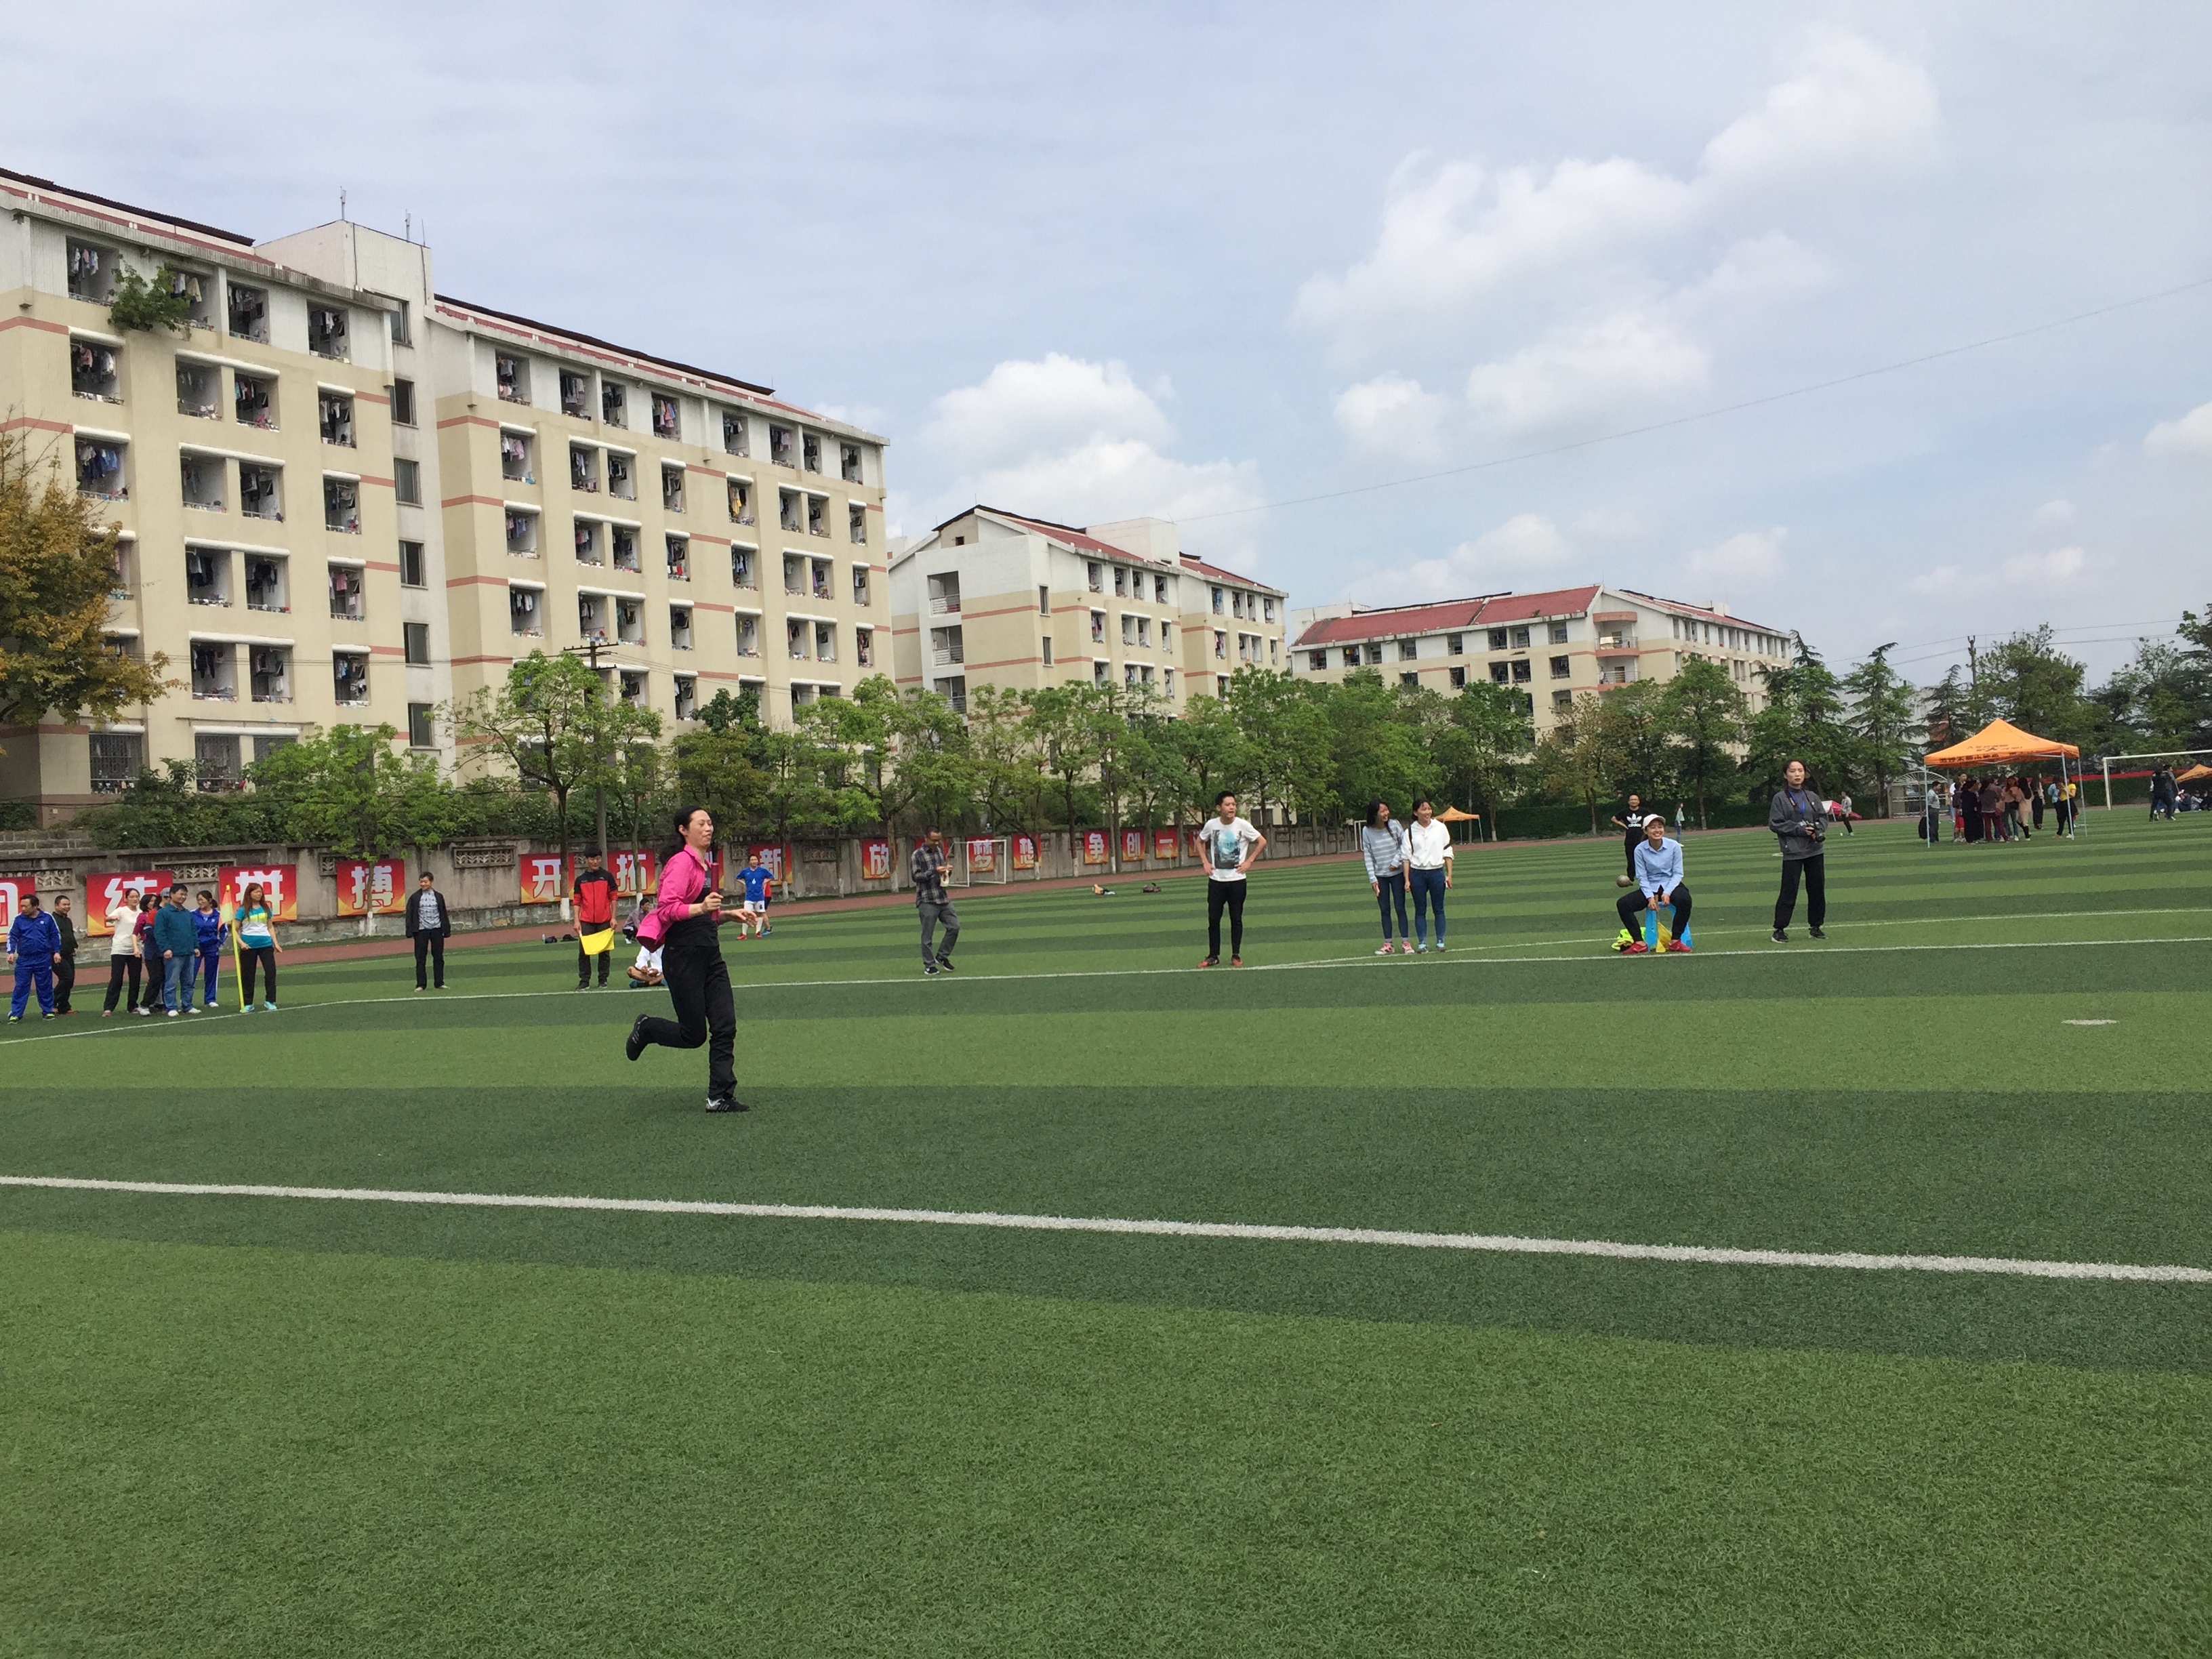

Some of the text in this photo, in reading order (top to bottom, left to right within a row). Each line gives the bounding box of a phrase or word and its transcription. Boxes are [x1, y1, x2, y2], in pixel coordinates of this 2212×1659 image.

[869, 844, 890, 875] 放
[974, 840, 992, 867] 梦
[1019, 838, 1036, 864] 想
[1088, 832, 1105, 860] 争
[1127, 832, 1141, 857] 创
[532, 859, 562, 898] 开
[616, 854, 647, 892] 拓
[760, 848, 782, 880] 新
[235, 870, 283, 916] 拼
[351, 865, 393, 909] 搏
